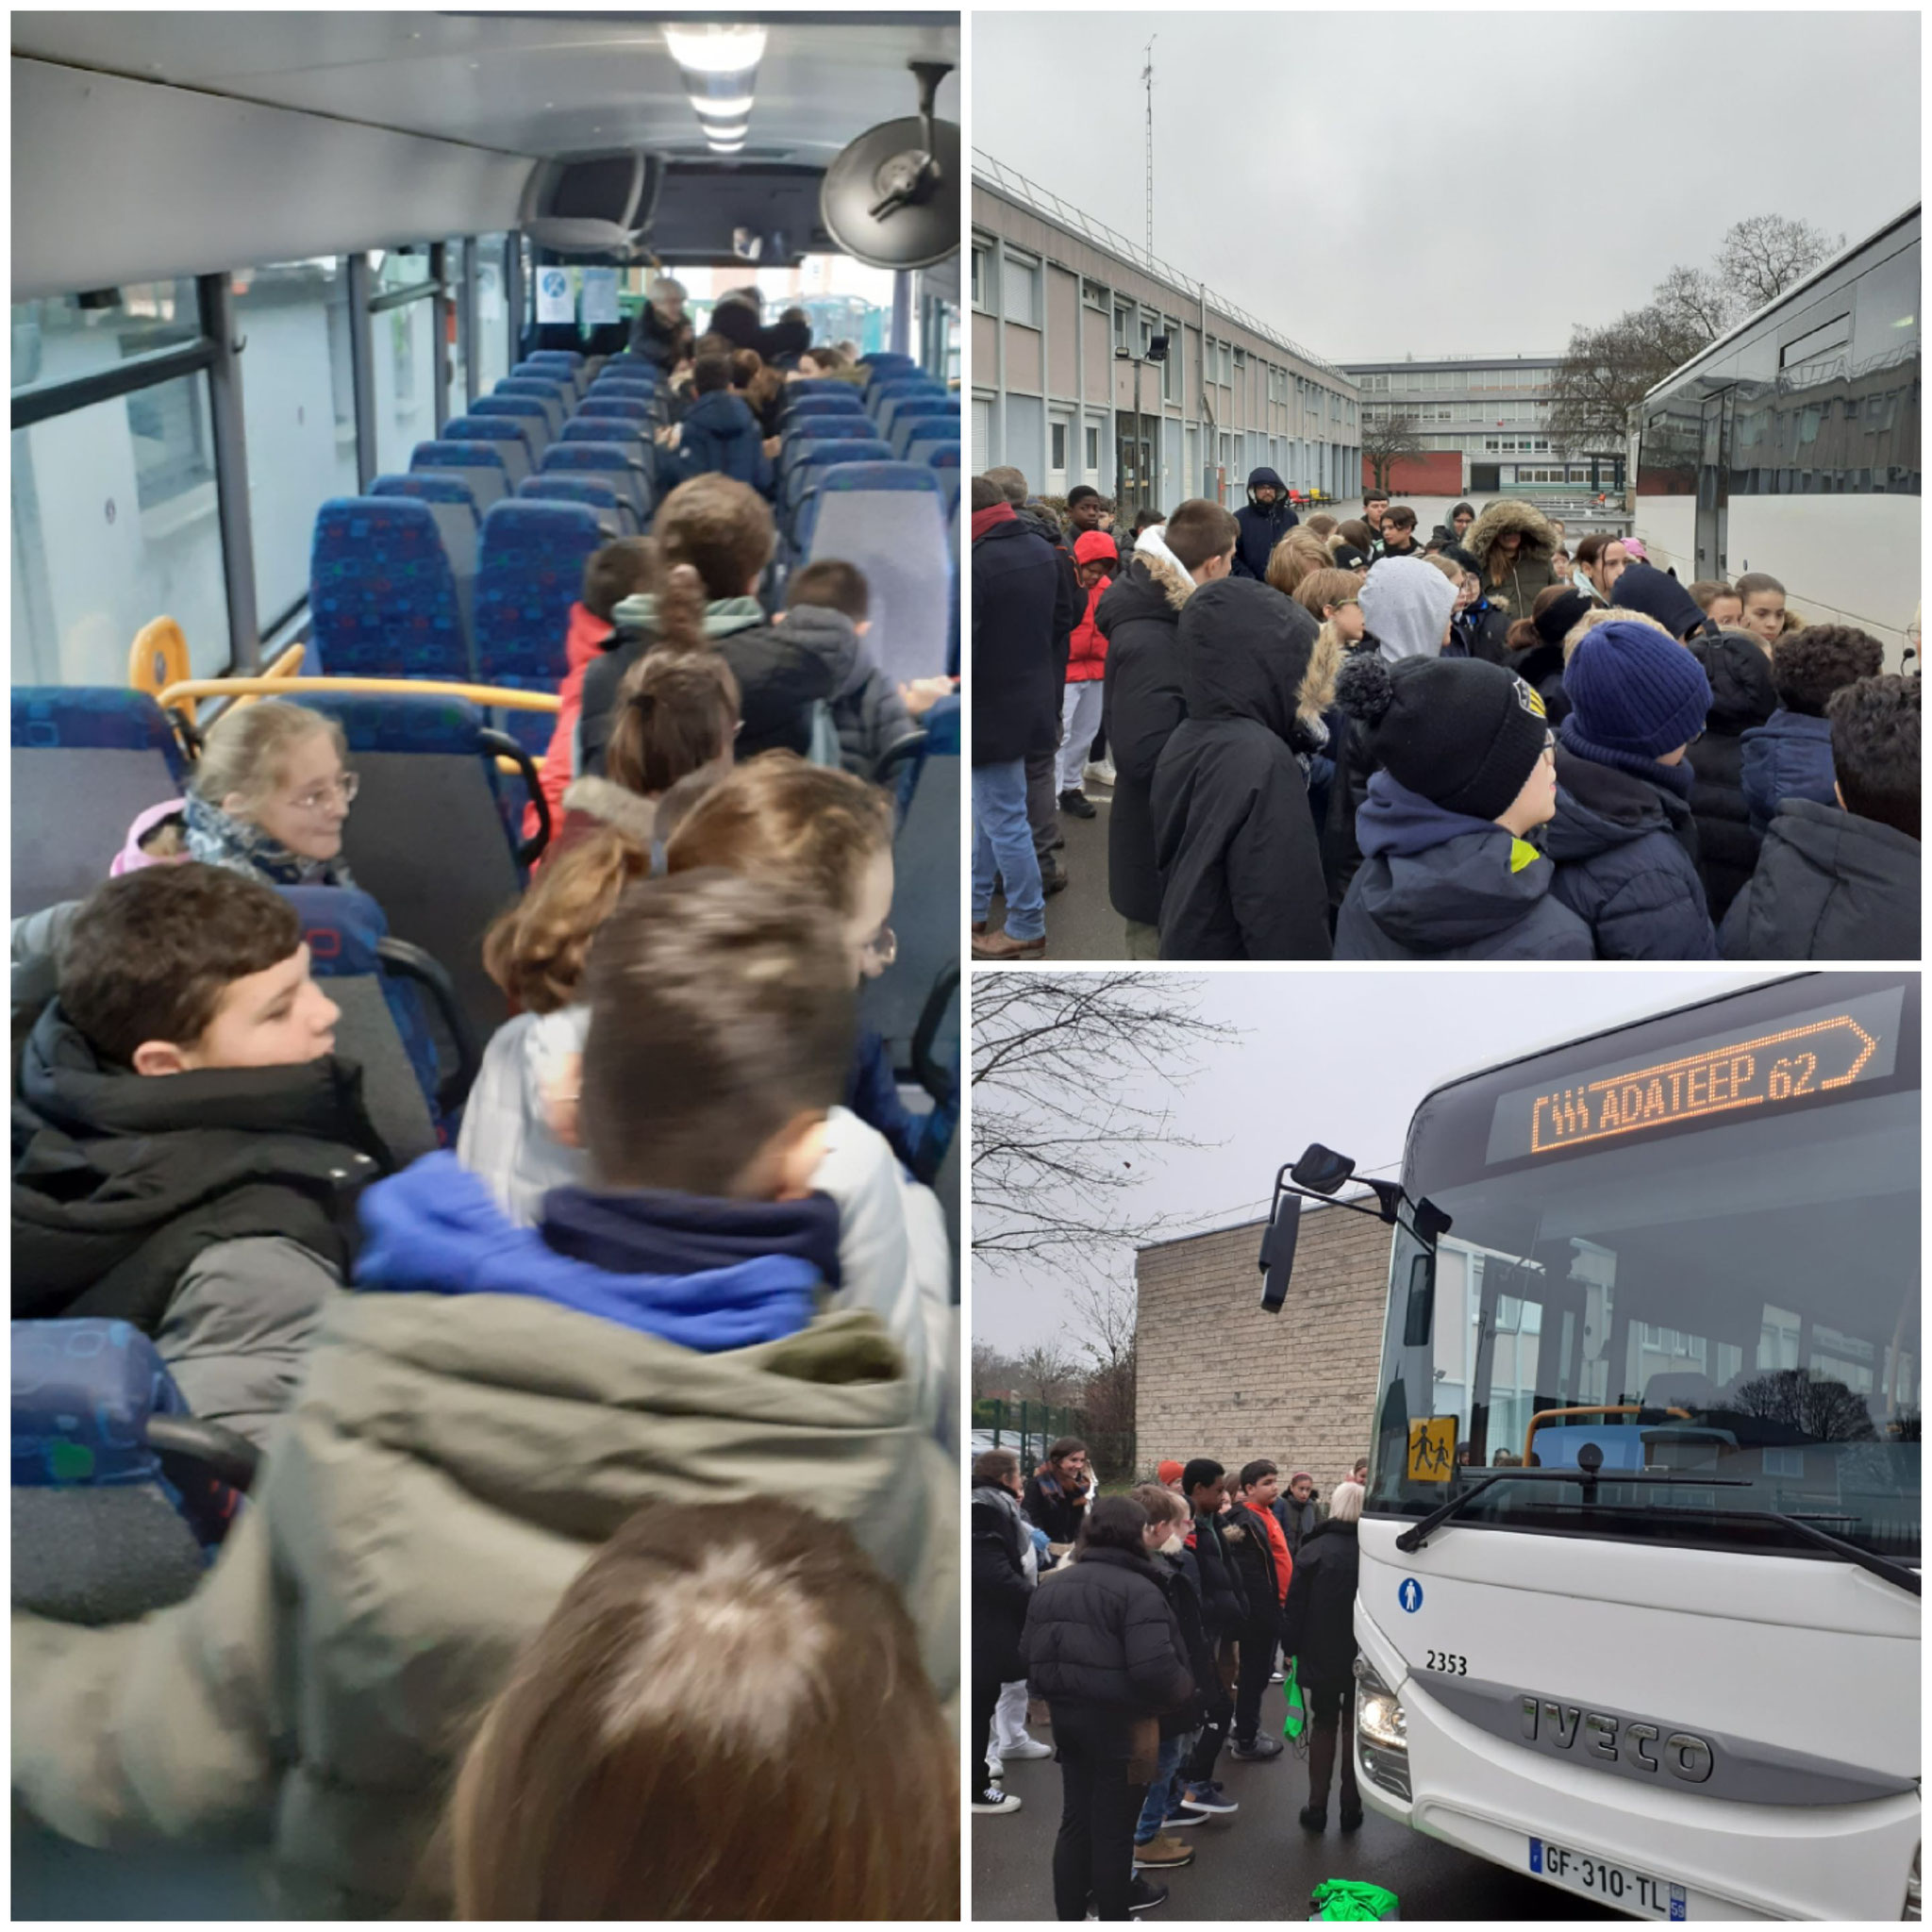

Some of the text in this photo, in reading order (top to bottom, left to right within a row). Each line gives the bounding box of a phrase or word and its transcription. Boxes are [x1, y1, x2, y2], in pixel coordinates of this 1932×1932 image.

[1600, 1052, 1817, 1129] ADATEEP 62
[1425, 1649, 1468, 1676] 2353
[1520, 1696, 1713, 1783] IVECO
[1546, 1846, 1666, 1913] GF-310-TL
[1671, 1901, 1685, 1918] 59
